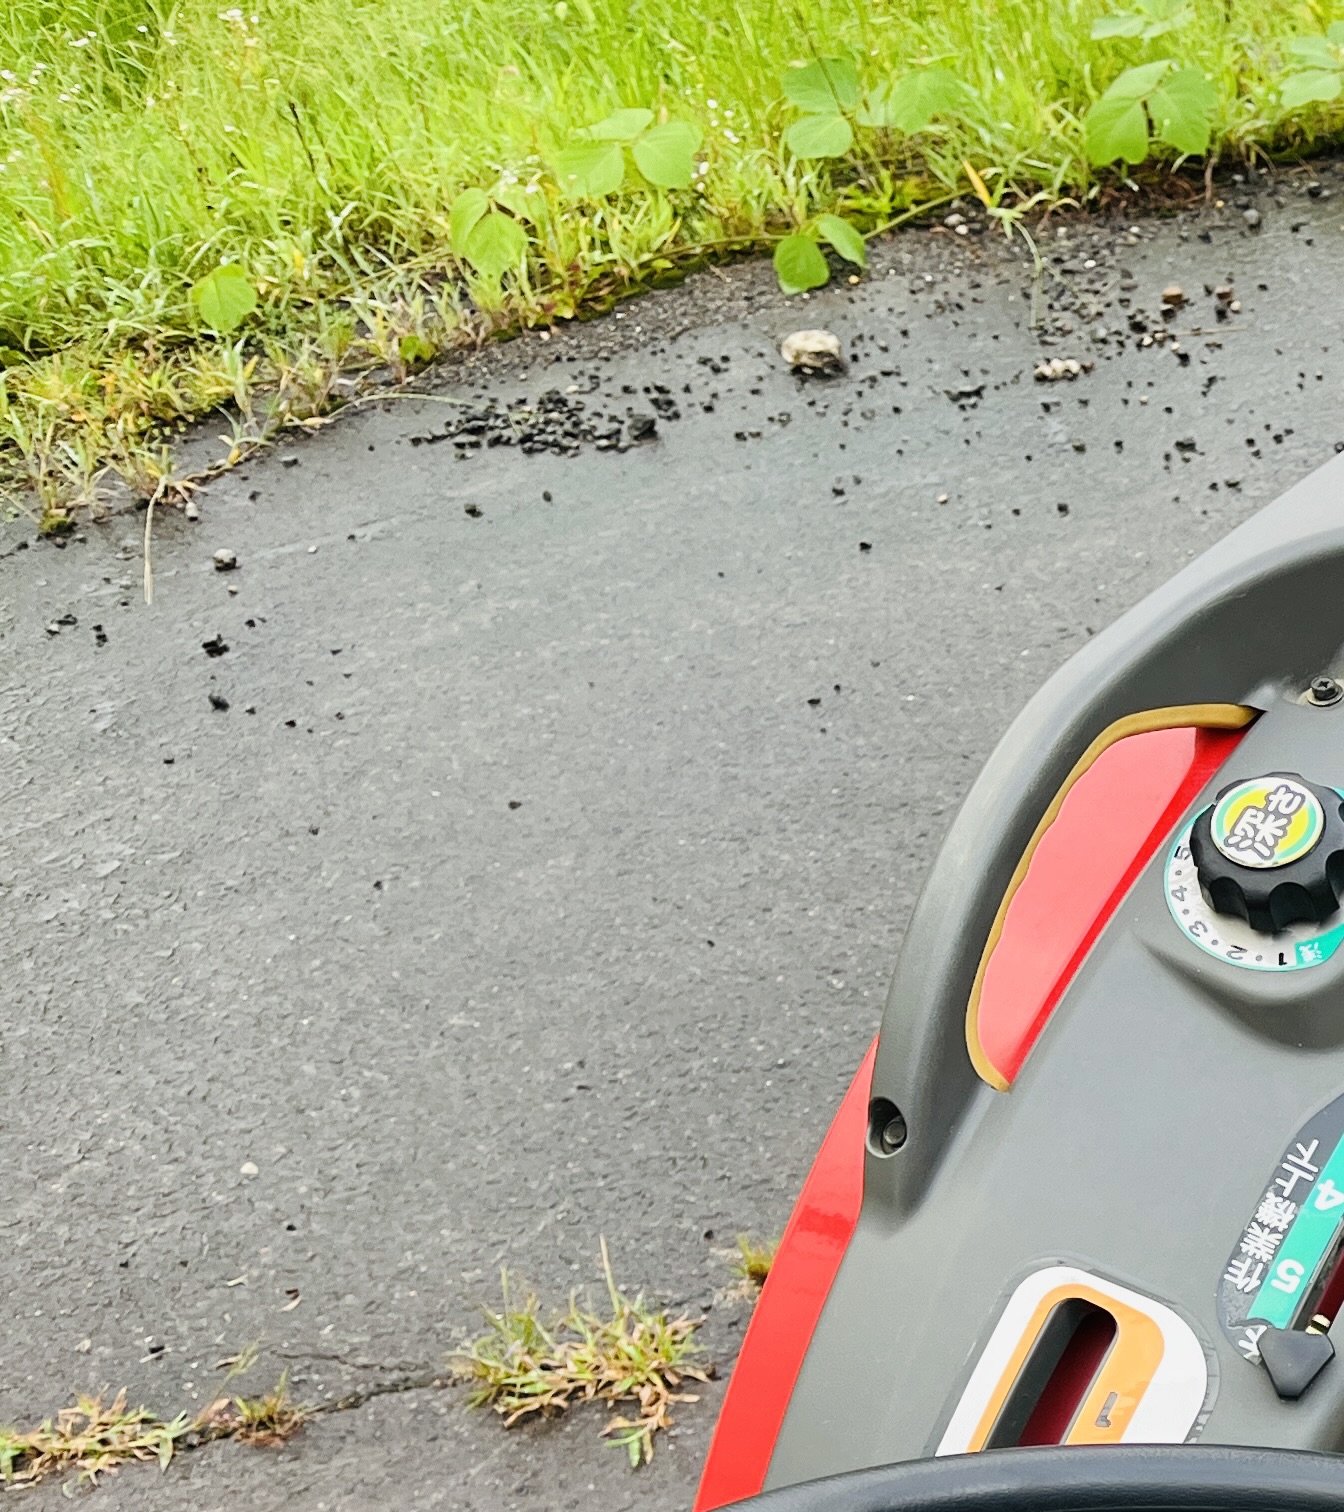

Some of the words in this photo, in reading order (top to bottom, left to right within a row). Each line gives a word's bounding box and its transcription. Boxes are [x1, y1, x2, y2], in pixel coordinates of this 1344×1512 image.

[1225, 783, 1304, 862] 深さ
[1173, 845, 1191, 861] 5
[1171, 886, 1189, 902] 4
[1189, 919, 1210, 938] 3
[1224, 944, 1248, 961] 2
[1276, 951, 1288, 966] 1
[1223, 1139, 1320, 1293] 作業機上下
[1269, 1259, 1305, 1293] 5
[1094, 1392, 1119, 1428] 1
